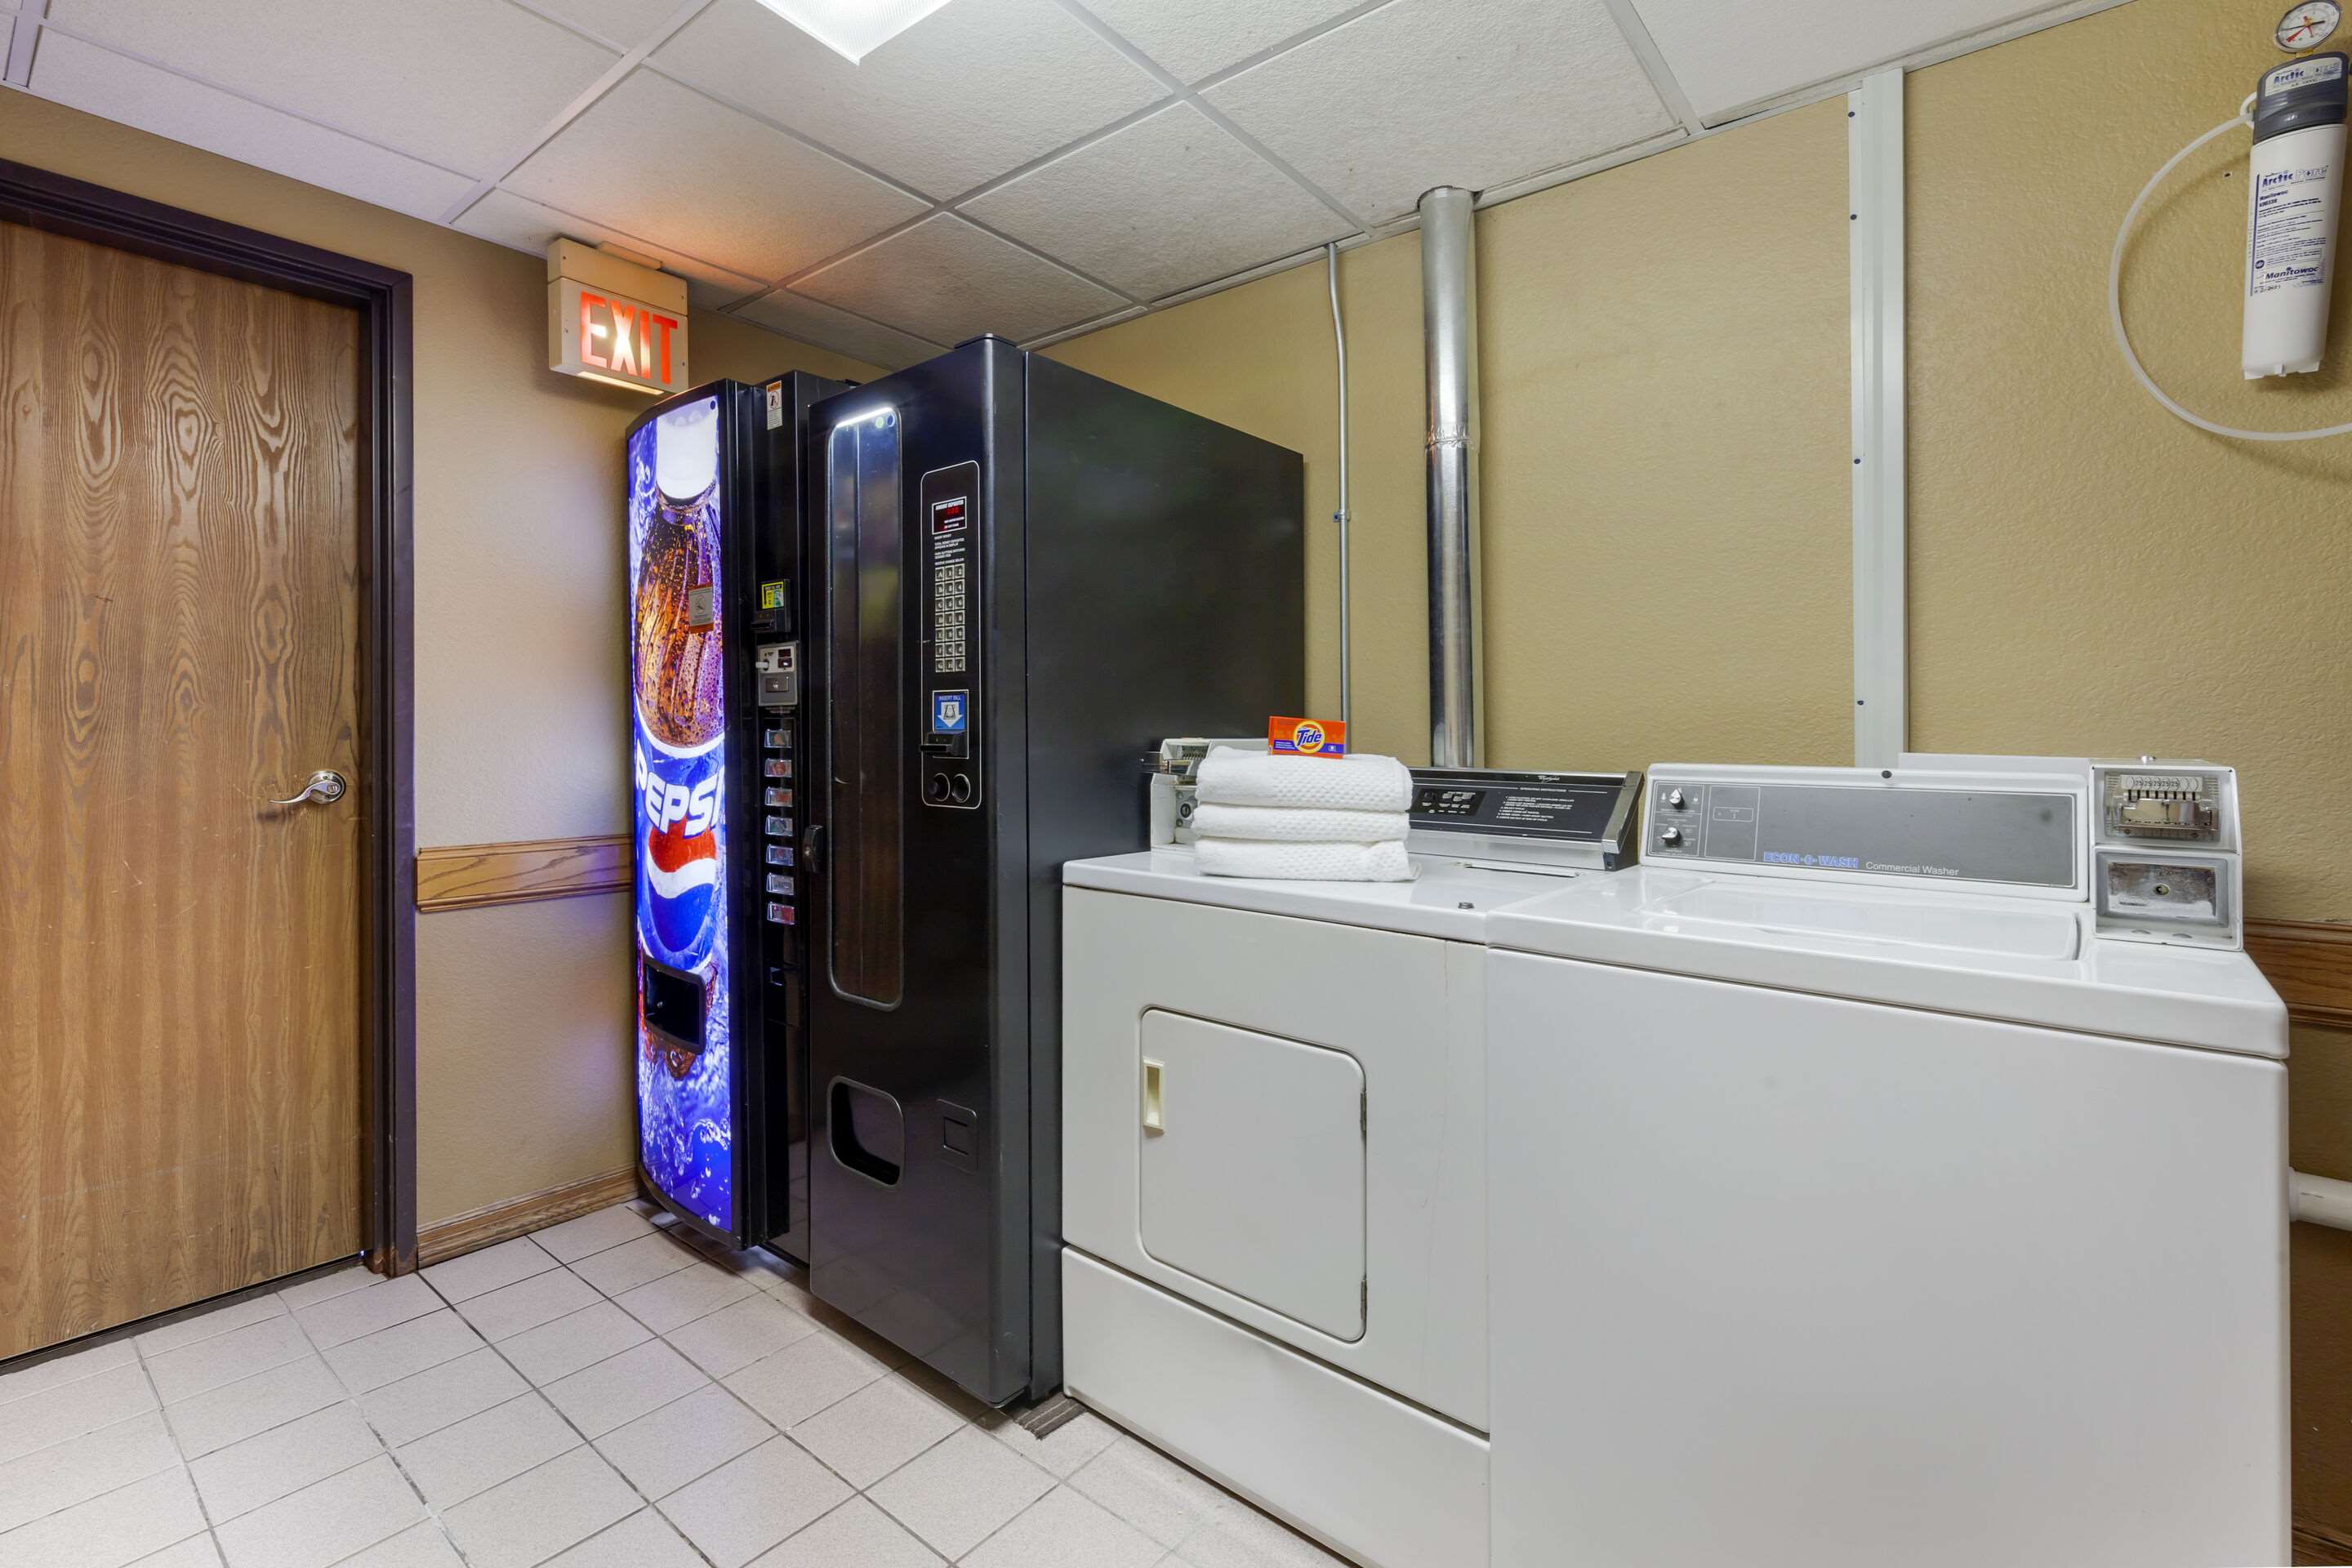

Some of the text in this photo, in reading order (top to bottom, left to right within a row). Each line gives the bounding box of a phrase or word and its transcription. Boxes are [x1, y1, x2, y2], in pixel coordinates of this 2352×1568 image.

[2273, 69, 2305, 84] Arctic
[2261, 172, 2293, 188] Arctic
[2265, 266, 2319, 280] Manitowoc
[581, 291, 678, 386] EXIT
[1297, 729, 1322, 746] Tide
[635, 743, 725, 837] PEPSI
[1866, 862, 1959, 876] Commercial Washer
